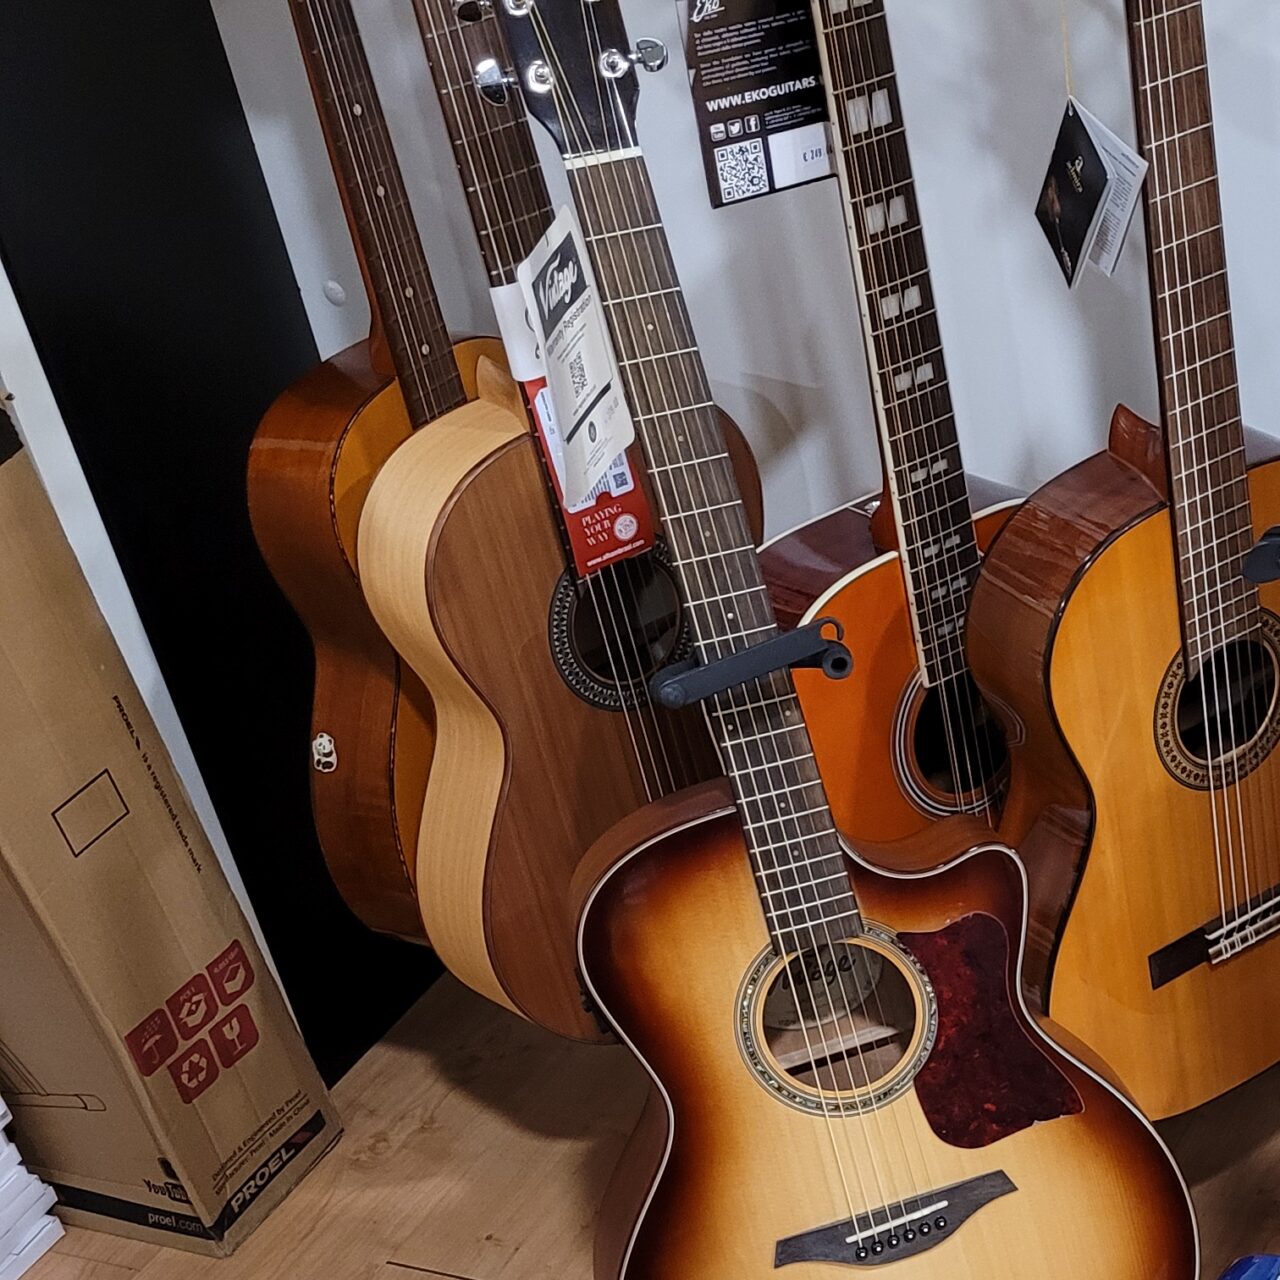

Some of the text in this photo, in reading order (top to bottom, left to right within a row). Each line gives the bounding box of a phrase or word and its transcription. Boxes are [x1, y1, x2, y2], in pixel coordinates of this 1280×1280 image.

[538, 252, 578, 320] Vintage
[581, 503, 623, 527] PLAYING
[584, 517, 612, 537] YOUR
[586, 530, 611, 547] WAY
[151, 771, 178, 823] registered
[175, 820, 190, 848] trade
[188, 848, 202, 874] mark
[143, 1178, 189, 1201] YouTub
[231, 1145, 296, 1213] PROEL
[148, 1212, 202, 1232] proel.com
